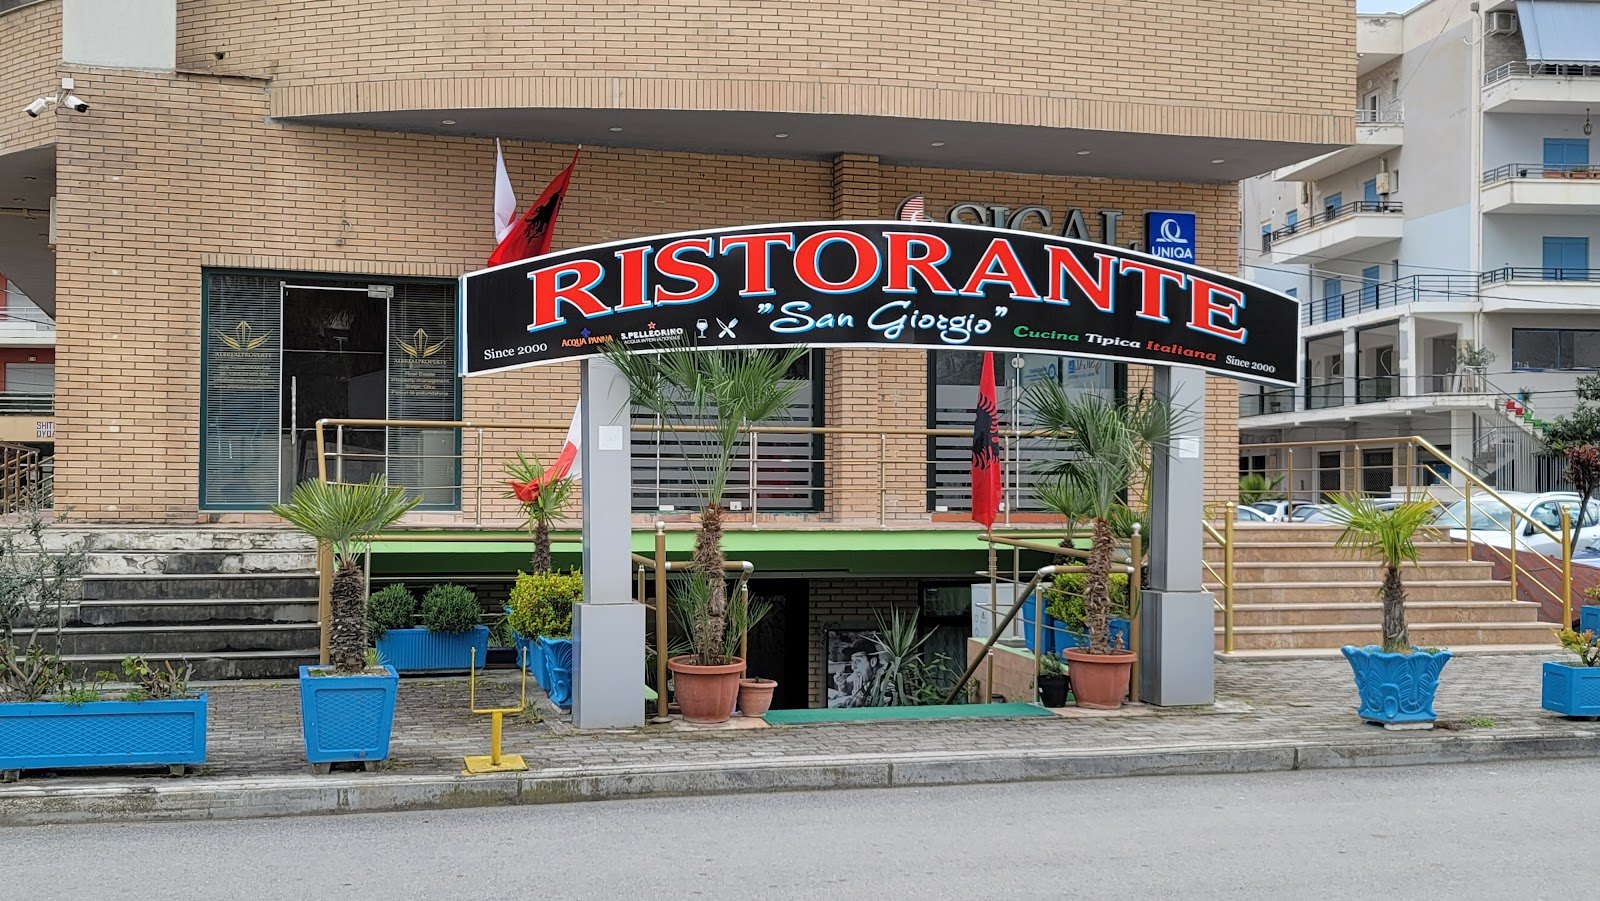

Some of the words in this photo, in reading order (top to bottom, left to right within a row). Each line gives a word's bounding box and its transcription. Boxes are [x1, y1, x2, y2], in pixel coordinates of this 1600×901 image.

[1151, 246, 1193, 260] UNIQA
[527, 230, 1247, 344] RISTORANTE
[561, 337, 587, 347] ACQUA
[588, 334, 614, 345] PANNA
[620, 327, 684, 340] S.PELLEGRINO
[484, 346, 515, 360] Since
[517, 342, 548, 355] 2000
[1013, 325, 1080, 341] Cucina
[1085, 332, 1141, 349] Tipica
[1146, 340, 1217, 361] Italiana
[1225, 354, 1250, 368] Since
[1251, 361, 1276, 373] 2000
